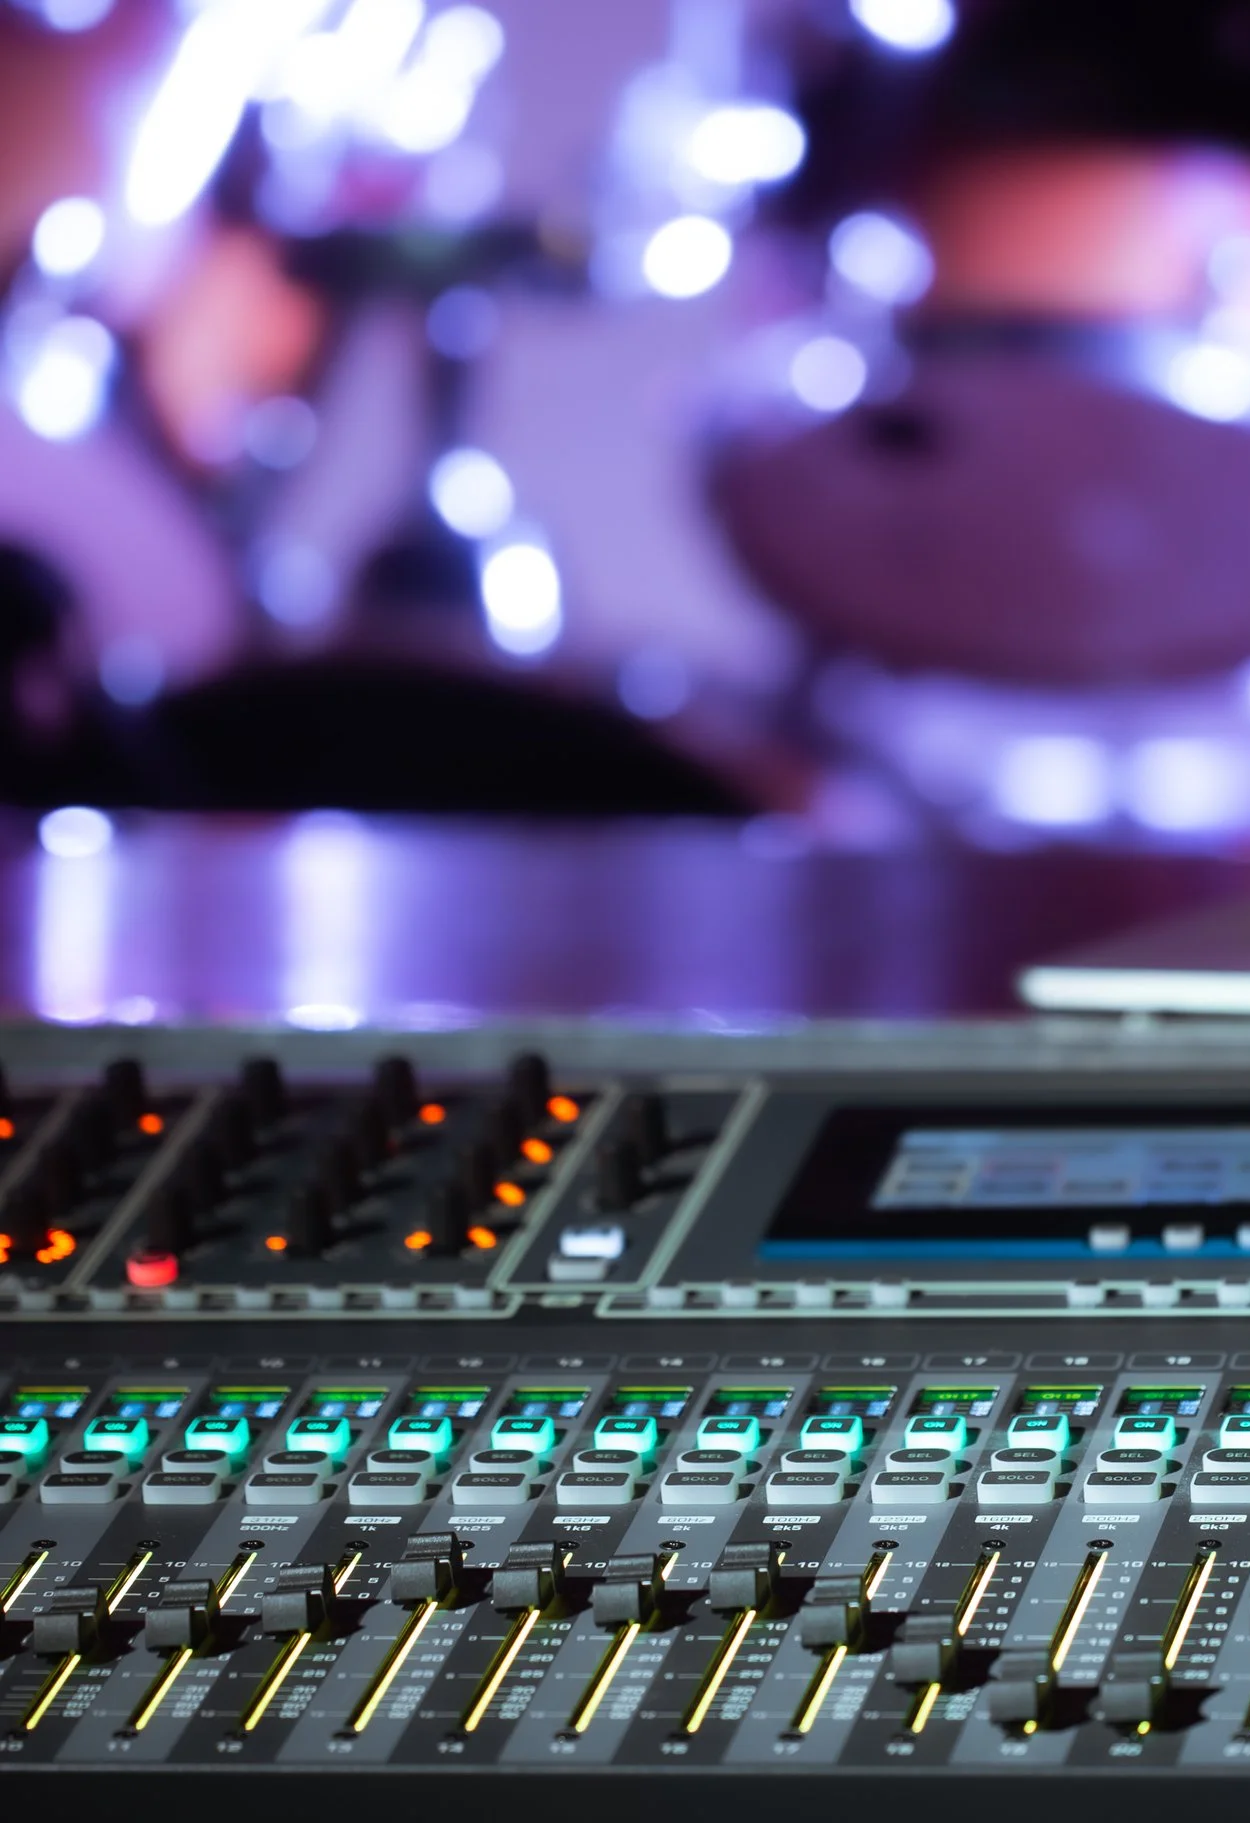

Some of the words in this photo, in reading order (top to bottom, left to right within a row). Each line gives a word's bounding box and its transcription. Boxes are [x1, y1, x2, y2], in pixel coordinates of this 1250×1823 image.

[923, 1420, 946, 1428] ON
[1026, 1419, 1049, 1428] ON
[1133, 1420, 1156, 1428] ON
[368, 1475, 407, 1483] SOLO
[681, 1475, 719, 1483] SOLO
[549, 1623, 572, 1631] 10
[420, 1654, 445, 1662] 20
